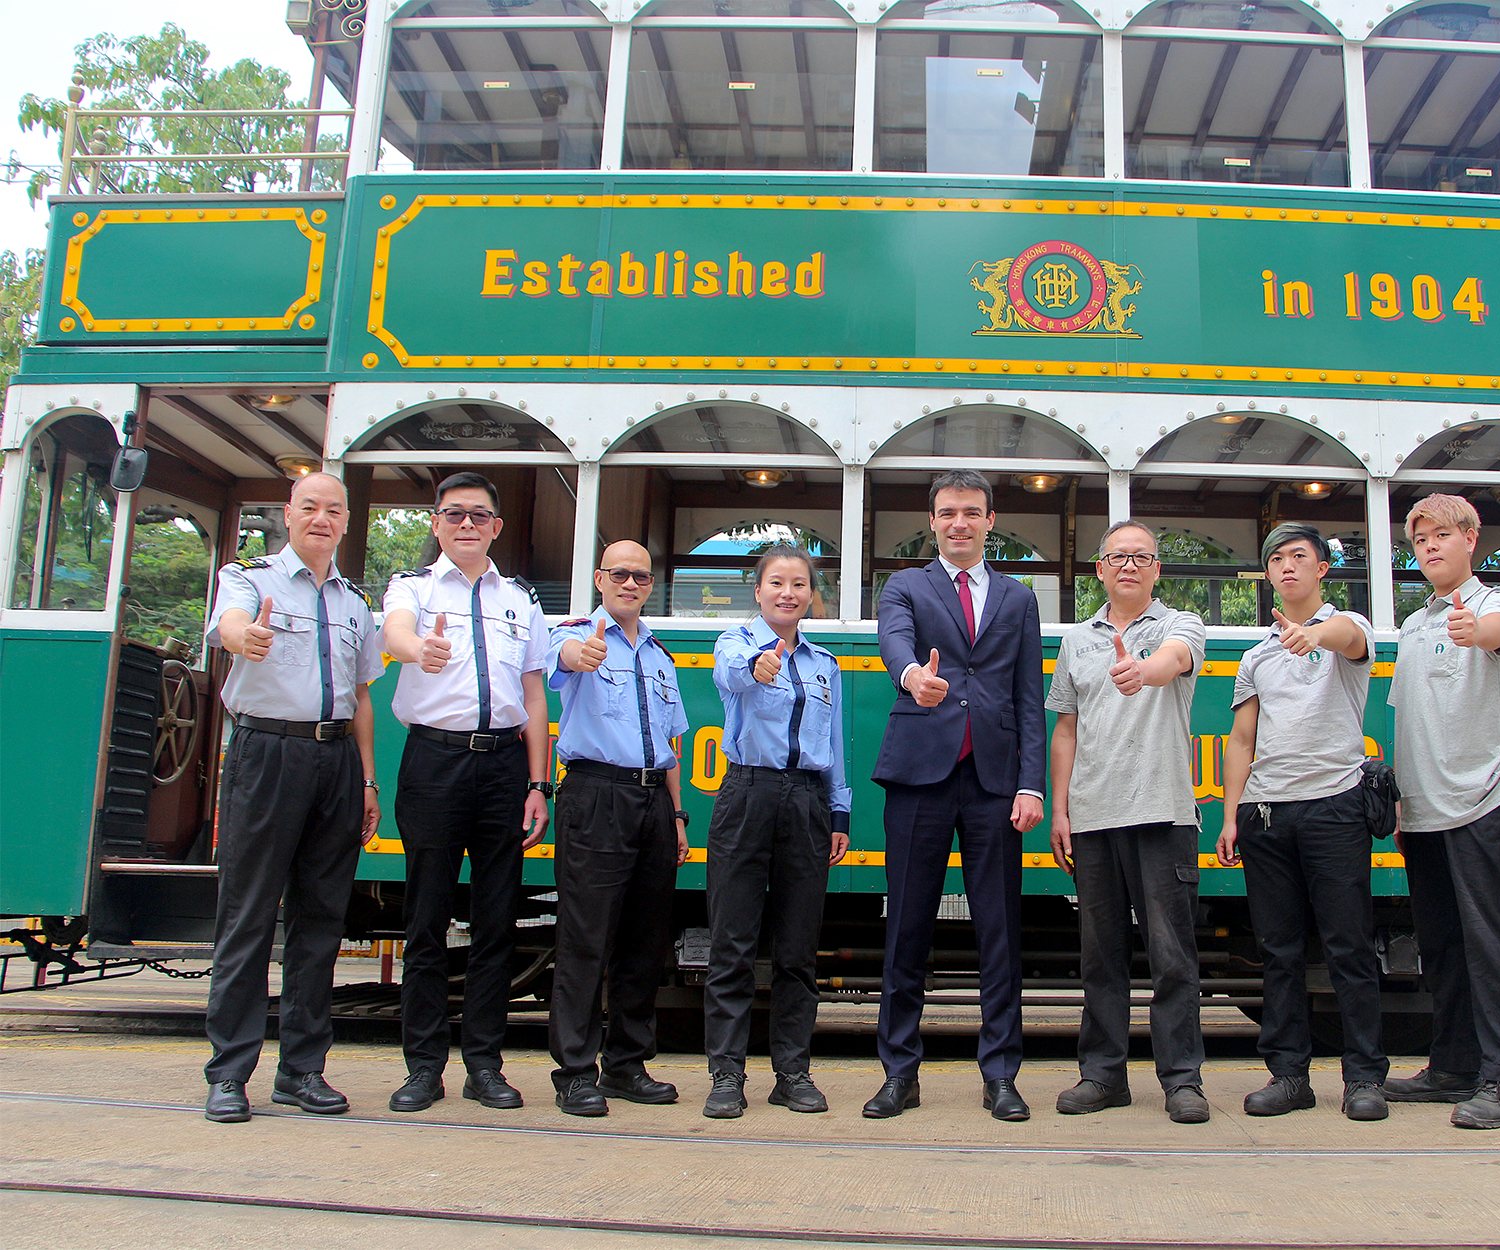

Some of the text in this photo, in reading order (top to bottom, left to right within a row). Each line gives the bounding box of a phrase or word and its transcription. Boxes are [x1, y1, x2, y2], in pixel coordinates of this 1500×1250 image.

[480, 249, 1489, 325] Established in 1904
[1012, 243, 1102, 281] HONG KONG TRAMWAYS
